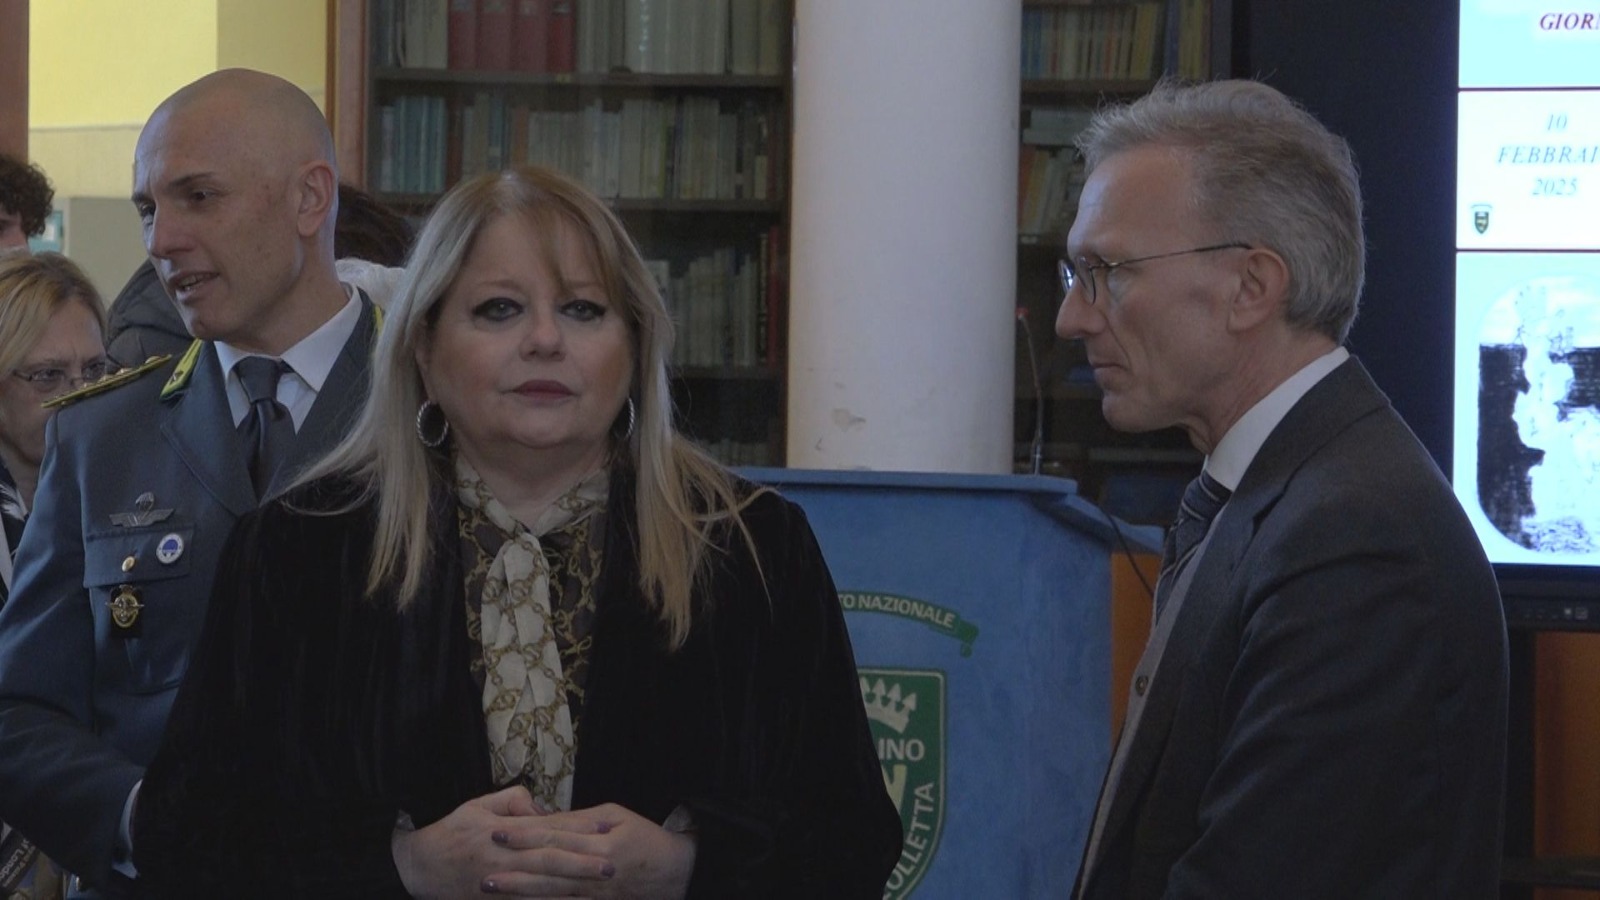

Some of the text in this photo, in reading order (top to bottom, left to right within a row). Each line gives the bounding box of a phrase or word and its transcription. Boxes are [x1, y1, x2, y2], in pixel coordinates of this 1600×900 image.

[1539, 12, 1600, 31] GIOR
[1547, 114, 1568, 131] 10
[1532, 178, 1577, 195] 2025
[858, 594, 956, 629] NAZIONALE
